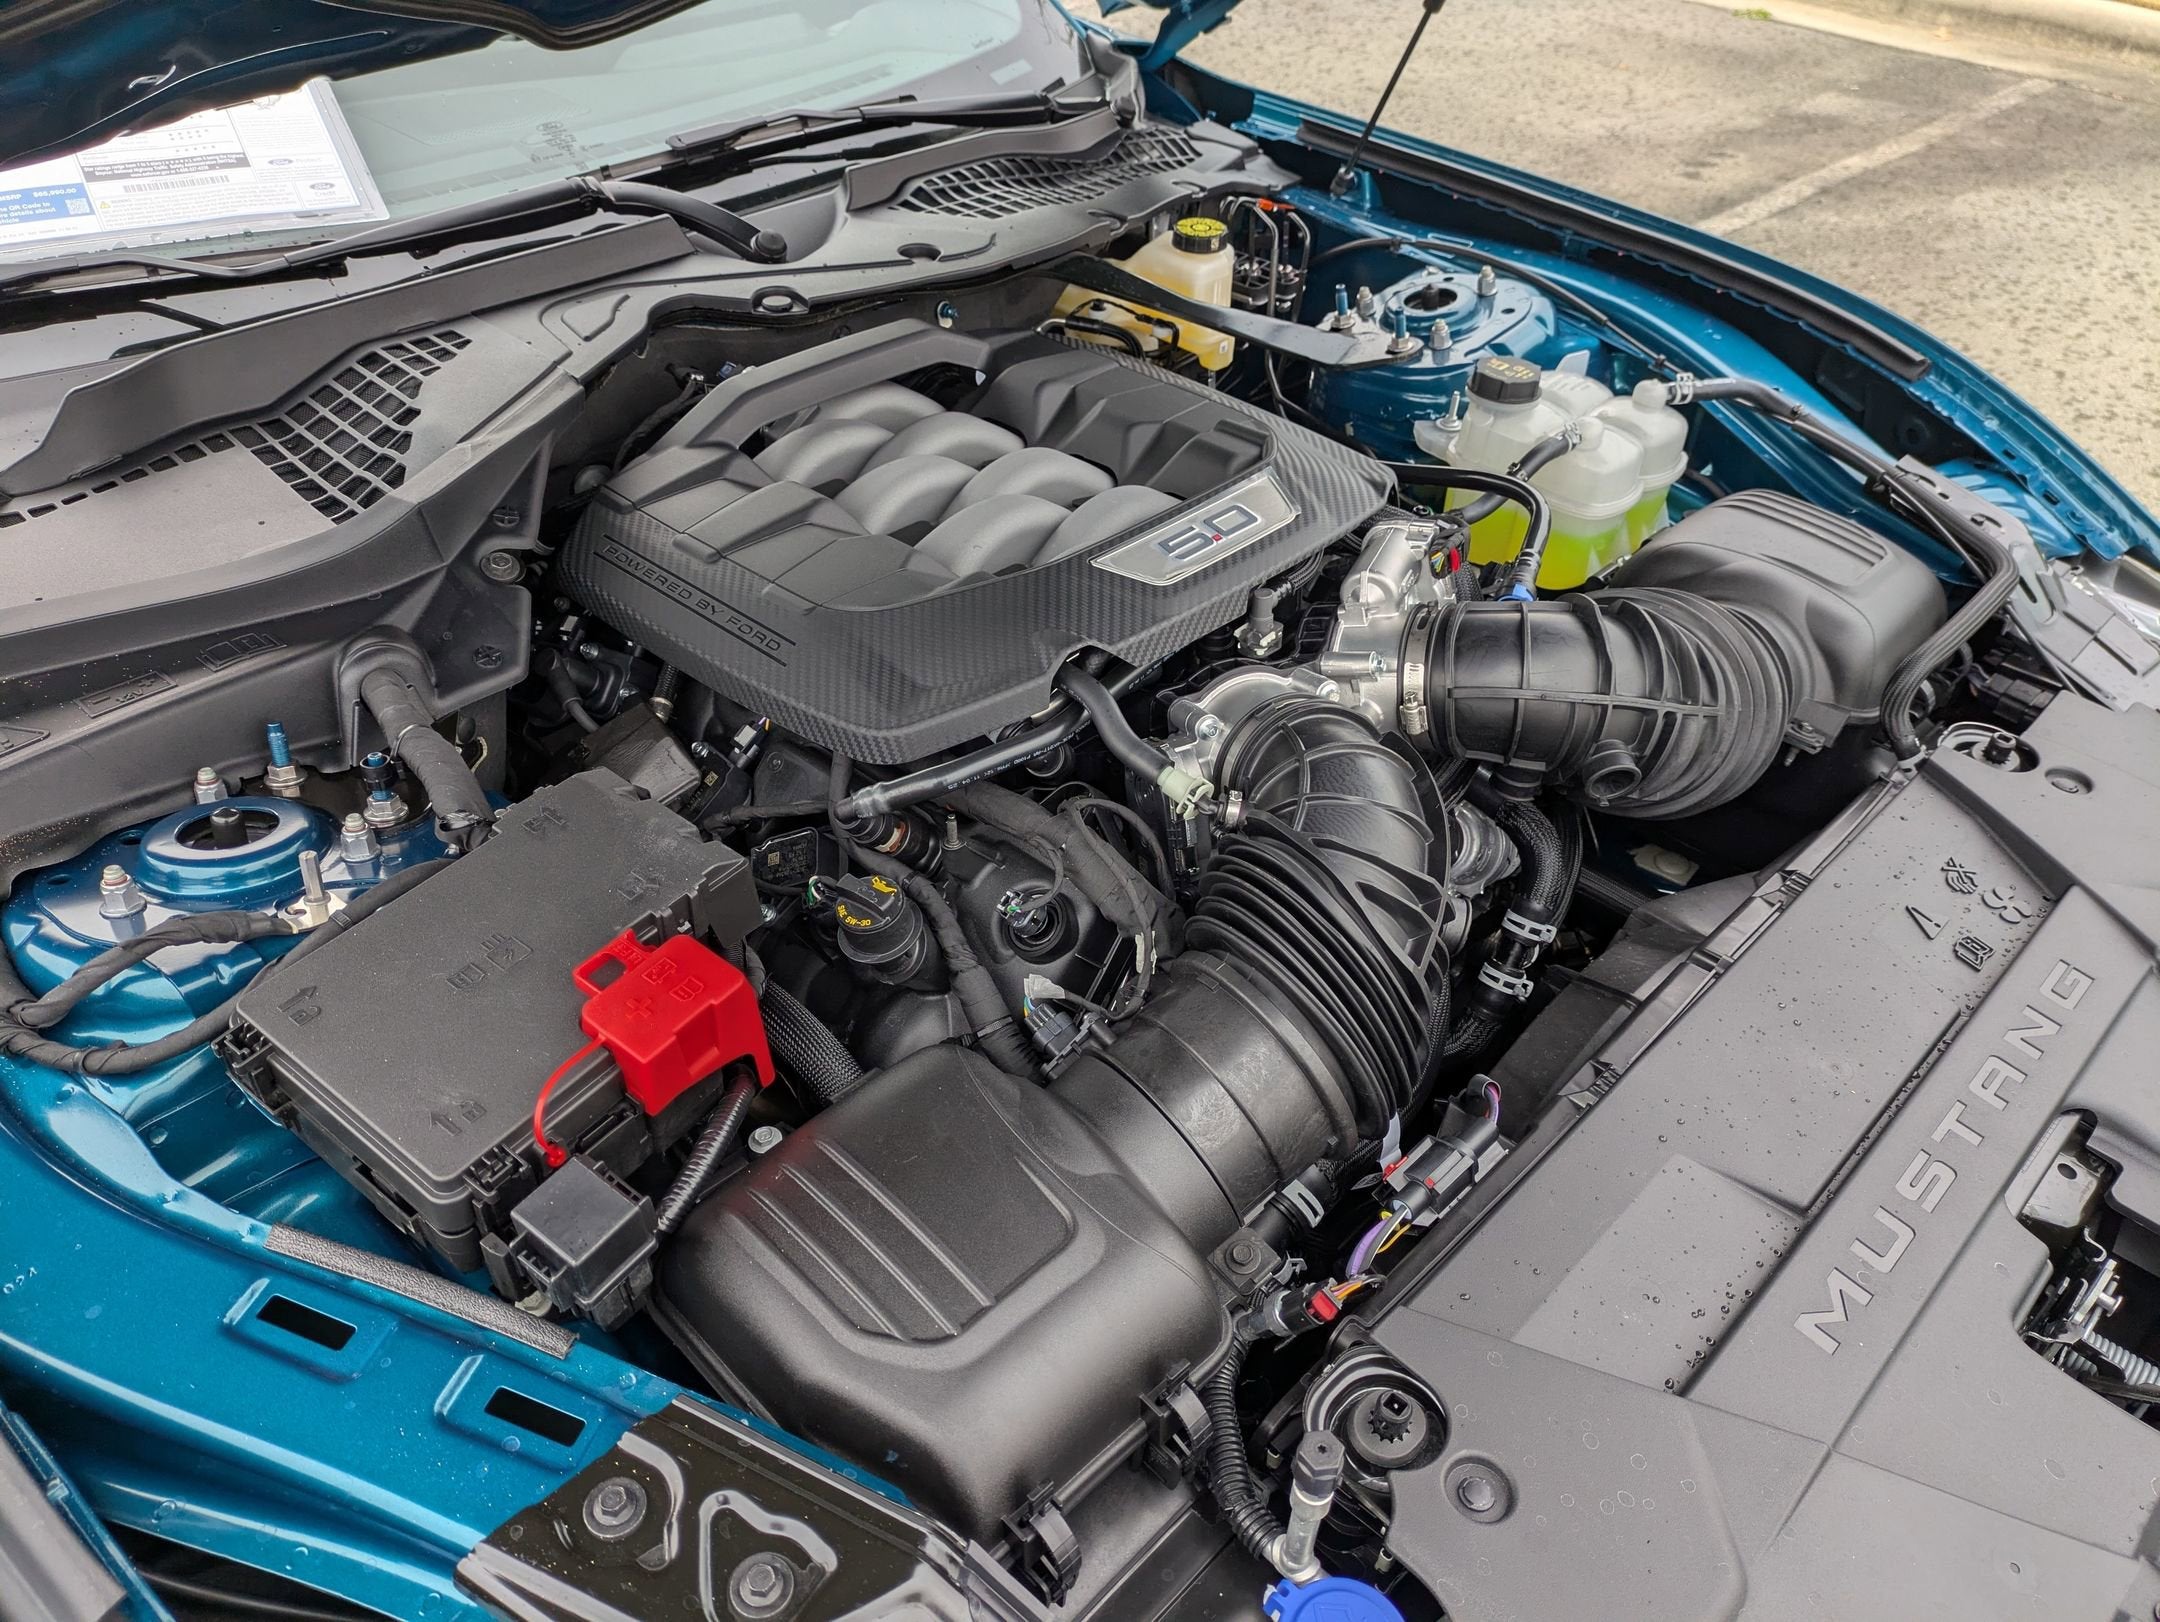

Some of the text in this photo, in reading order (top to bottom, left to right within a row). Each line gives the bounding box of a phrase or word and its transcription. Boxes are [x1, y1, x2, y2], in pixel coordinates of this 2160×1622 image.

[1157, 504, 1261, 561] 5.0
[603, 545, 782, 651] POWERED BY FORD
[837, 904, 872, 927] SAE 5W-30
[1794, 959, 2095, 1356] MUSTANG
